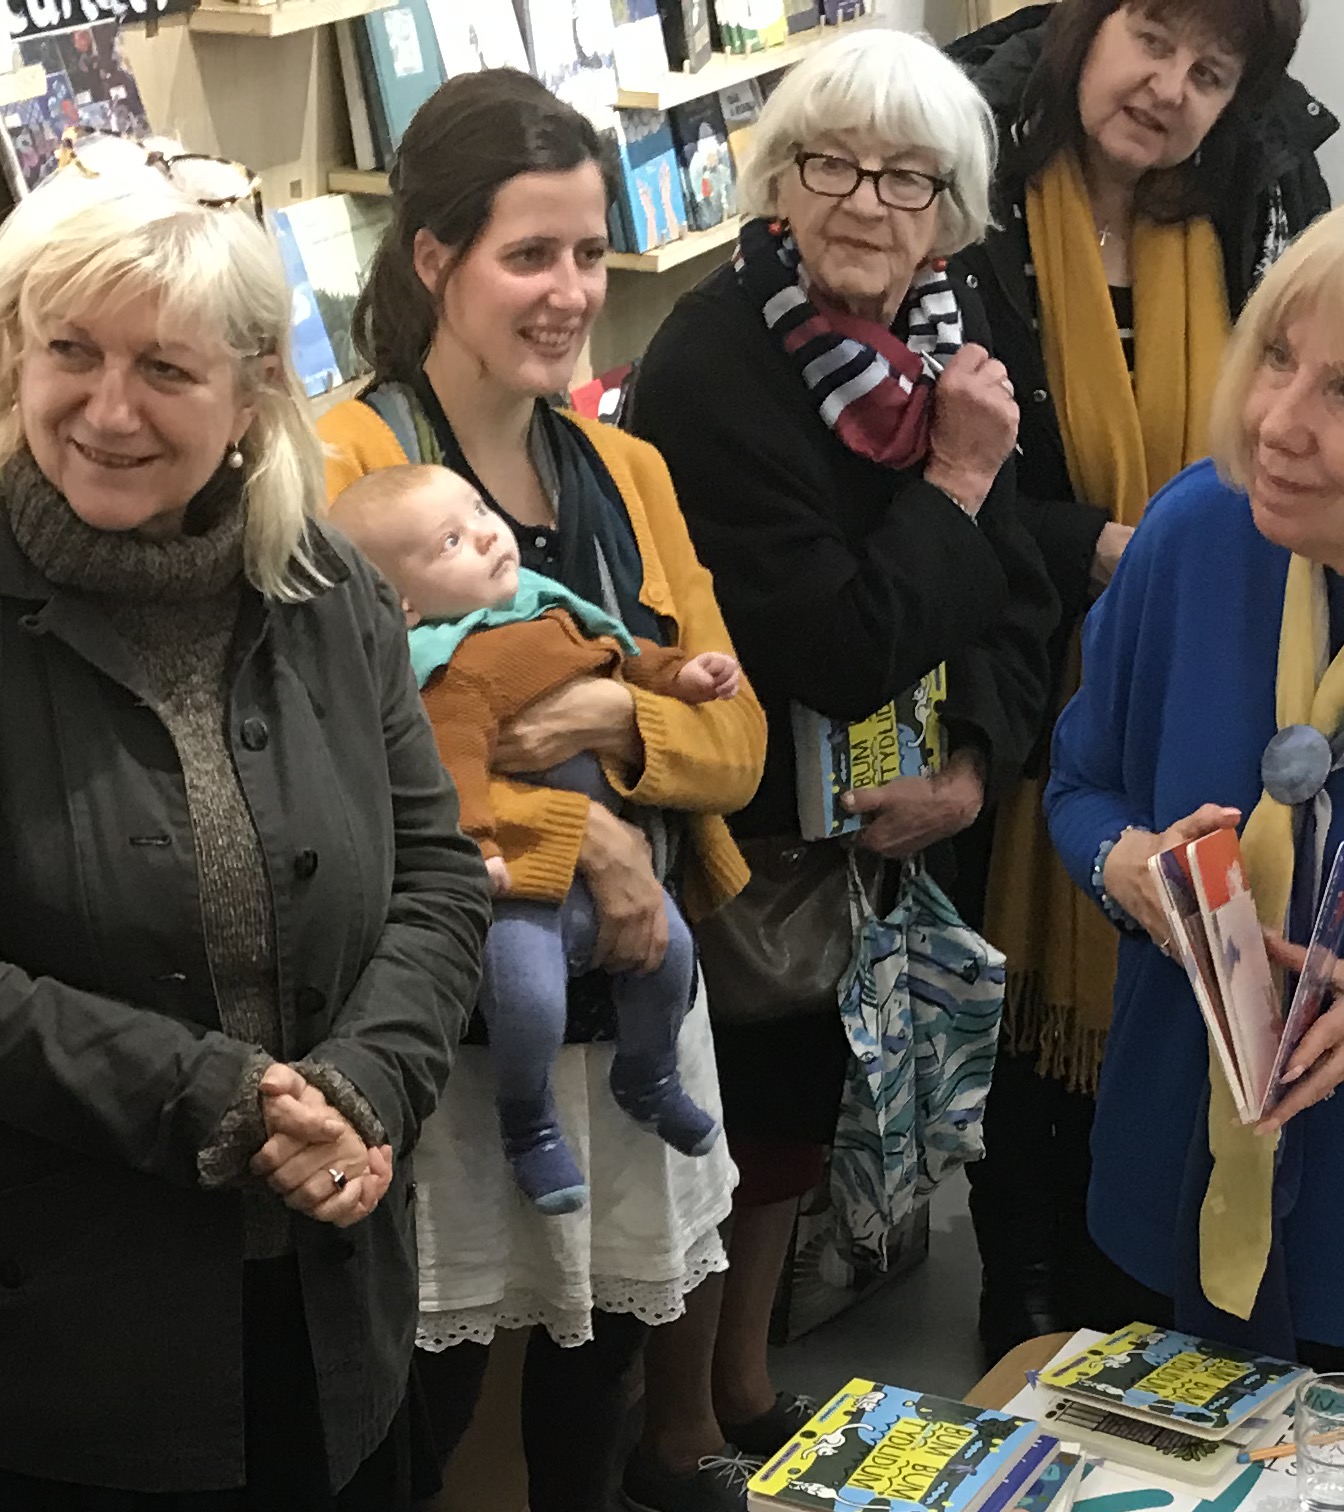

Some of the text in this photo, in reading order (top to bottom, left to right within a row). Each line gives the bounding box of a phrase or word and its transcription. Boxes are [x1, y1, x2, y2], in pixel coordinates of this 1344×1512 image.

[851, 1420, 926, 1491] TYDLIDUM
[896, 1426, 973, 1502] BUM BUM
